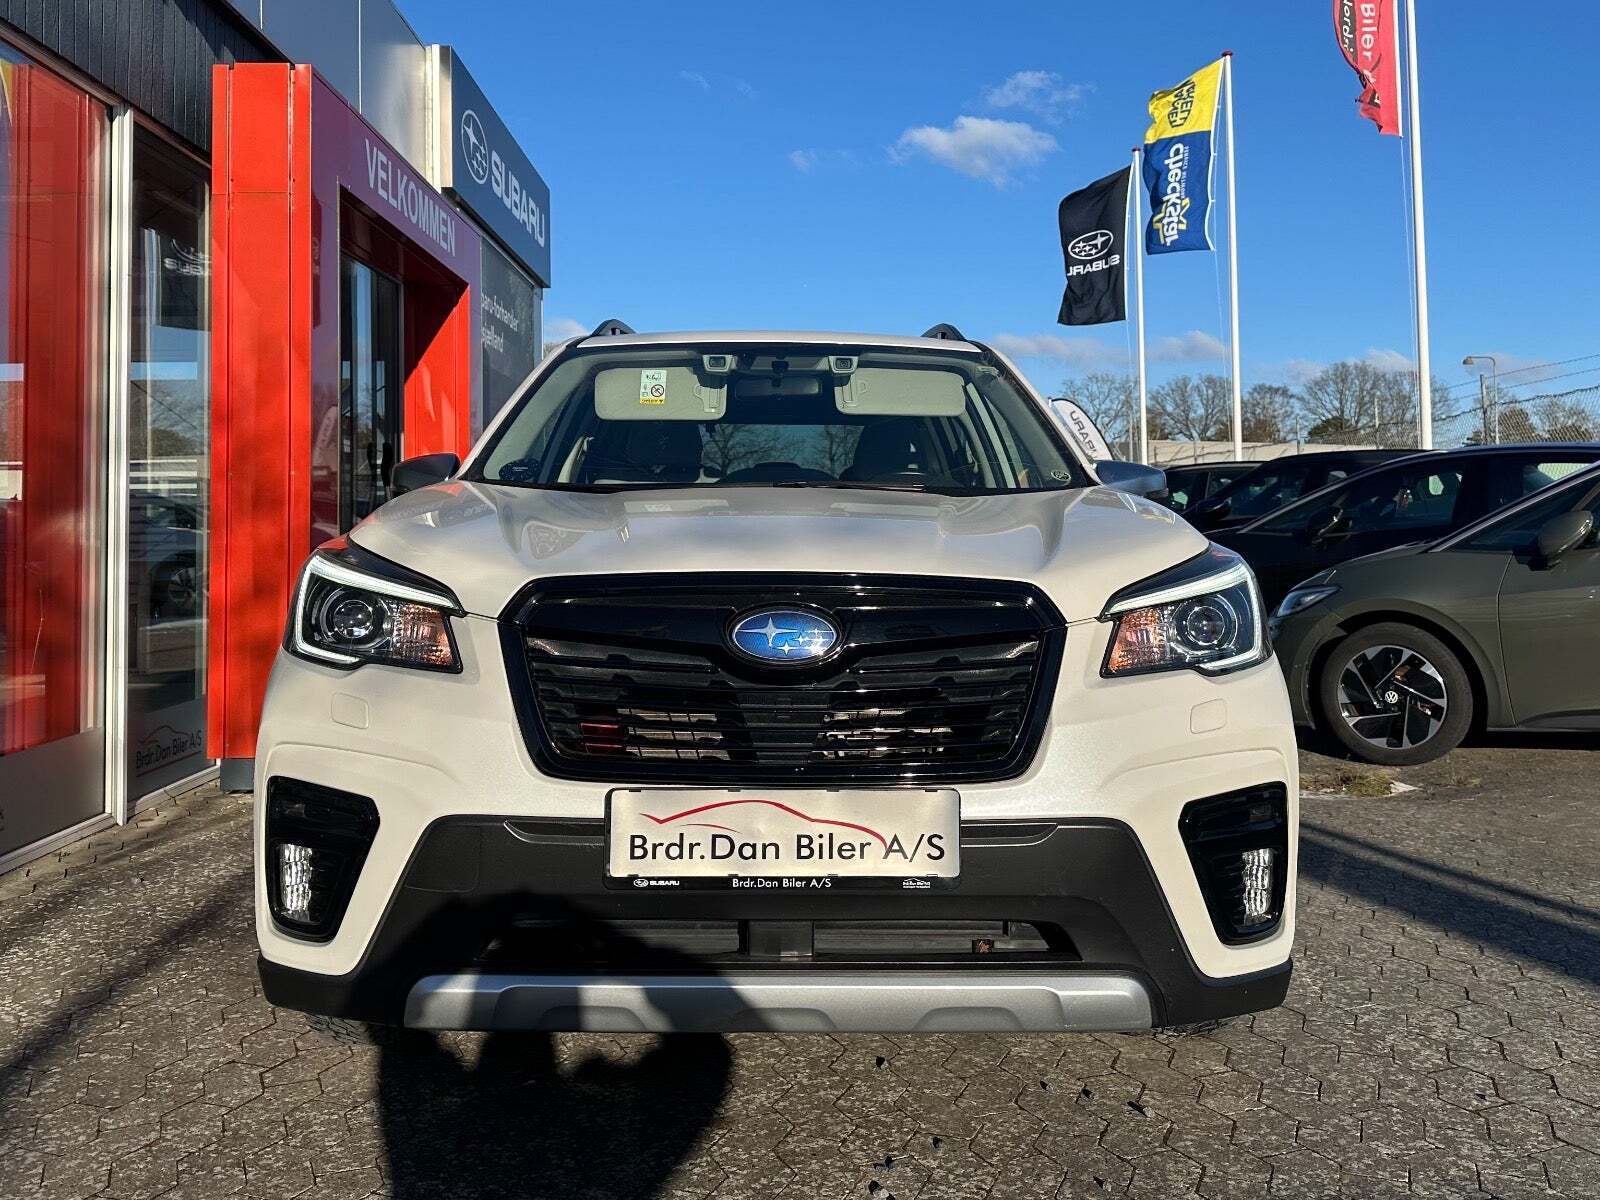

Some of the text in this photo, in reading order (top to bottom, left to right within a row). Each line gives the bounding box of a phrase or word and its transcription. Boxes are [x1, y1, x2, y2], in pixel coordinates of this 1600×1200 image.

[1360, 3, 1378, 61] Biler
[365, 138, 456, 257] VELKOMMEN
[491, 150, 545, 248] SUBARU
[629, 831, 946, 863] Brdr.Dan Biler A/S
[732, 878, 832, 889] Brdr.Dan Biler A/S
